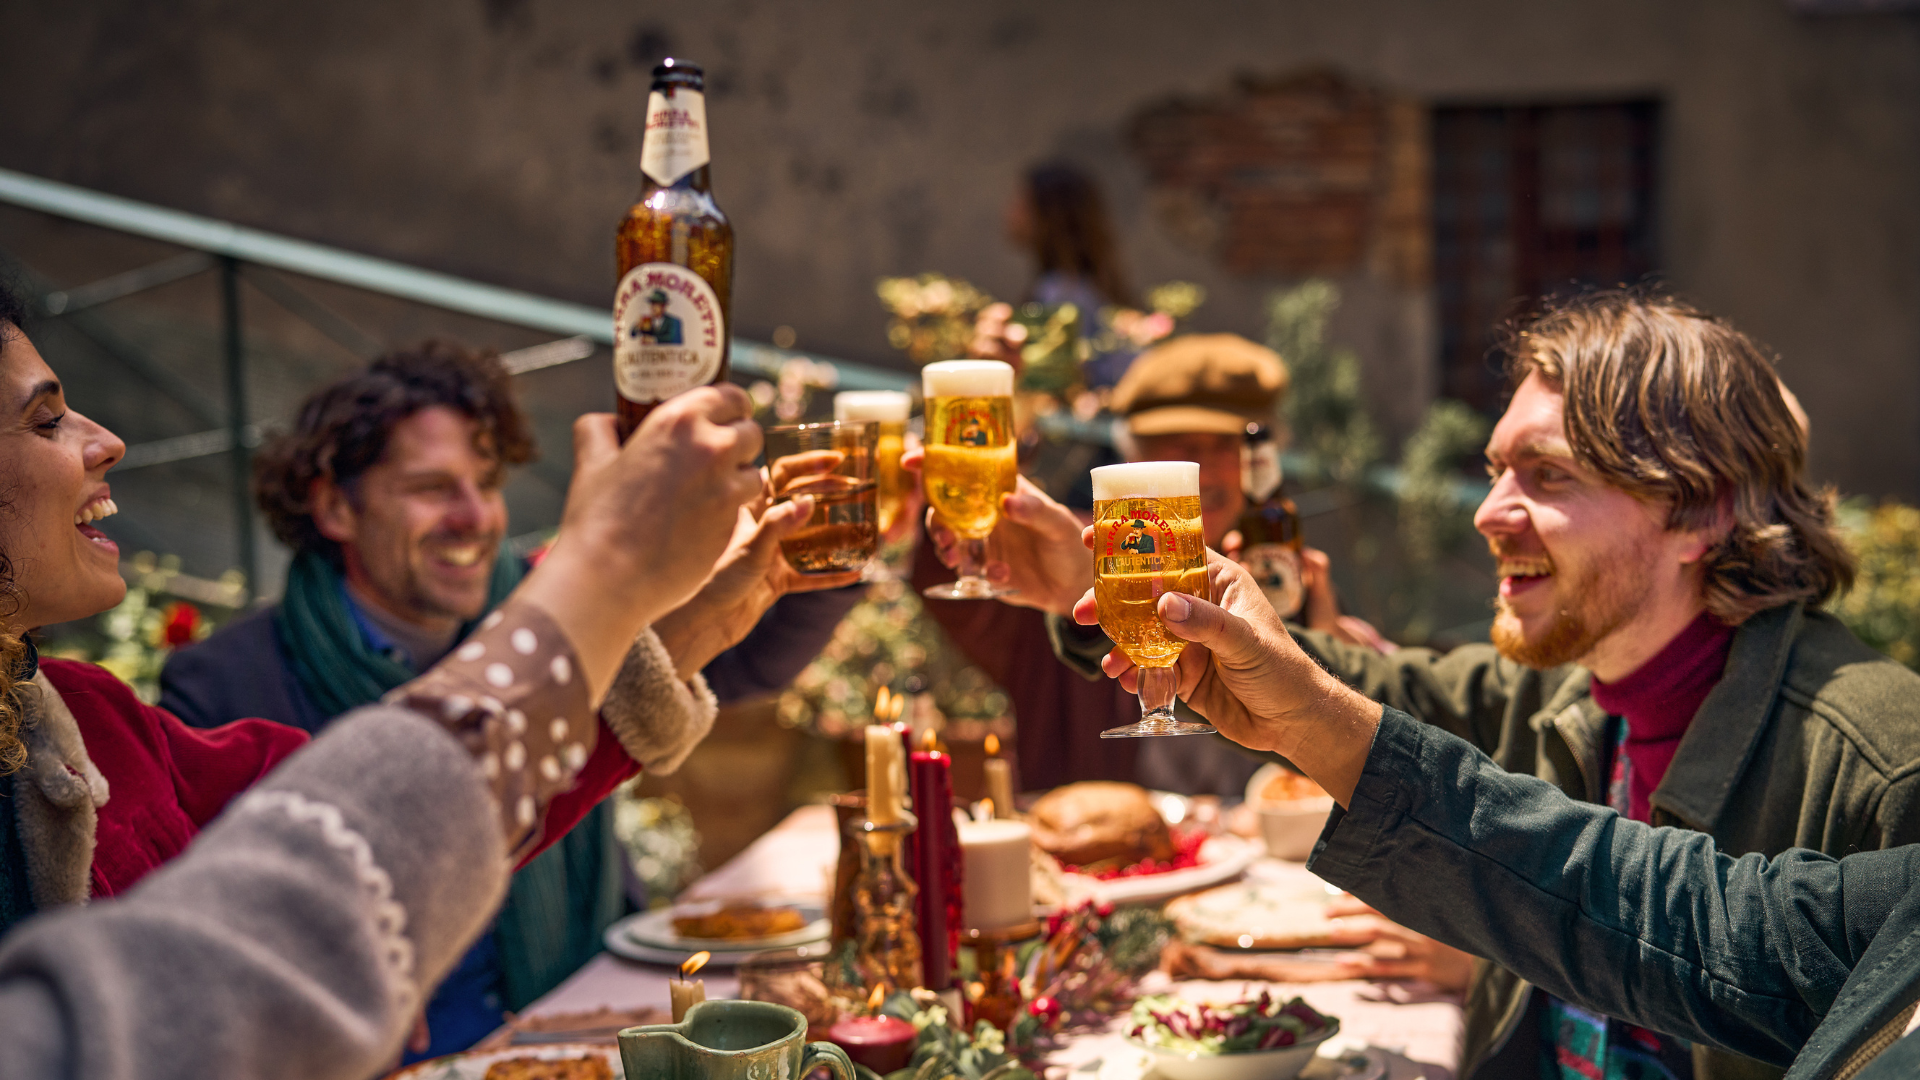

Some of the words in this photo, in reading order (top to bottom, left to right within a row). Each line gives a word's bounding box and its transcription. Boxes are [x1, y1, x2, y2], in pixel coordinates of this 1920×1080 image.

[647, 272, 717, 347] MORETTI
[1106, 514, 1130, 556] BIRRA
[1130, 510, 1176, 552] MORETTI
[1115, 556, 1166, 567] L'AUTENTICA
